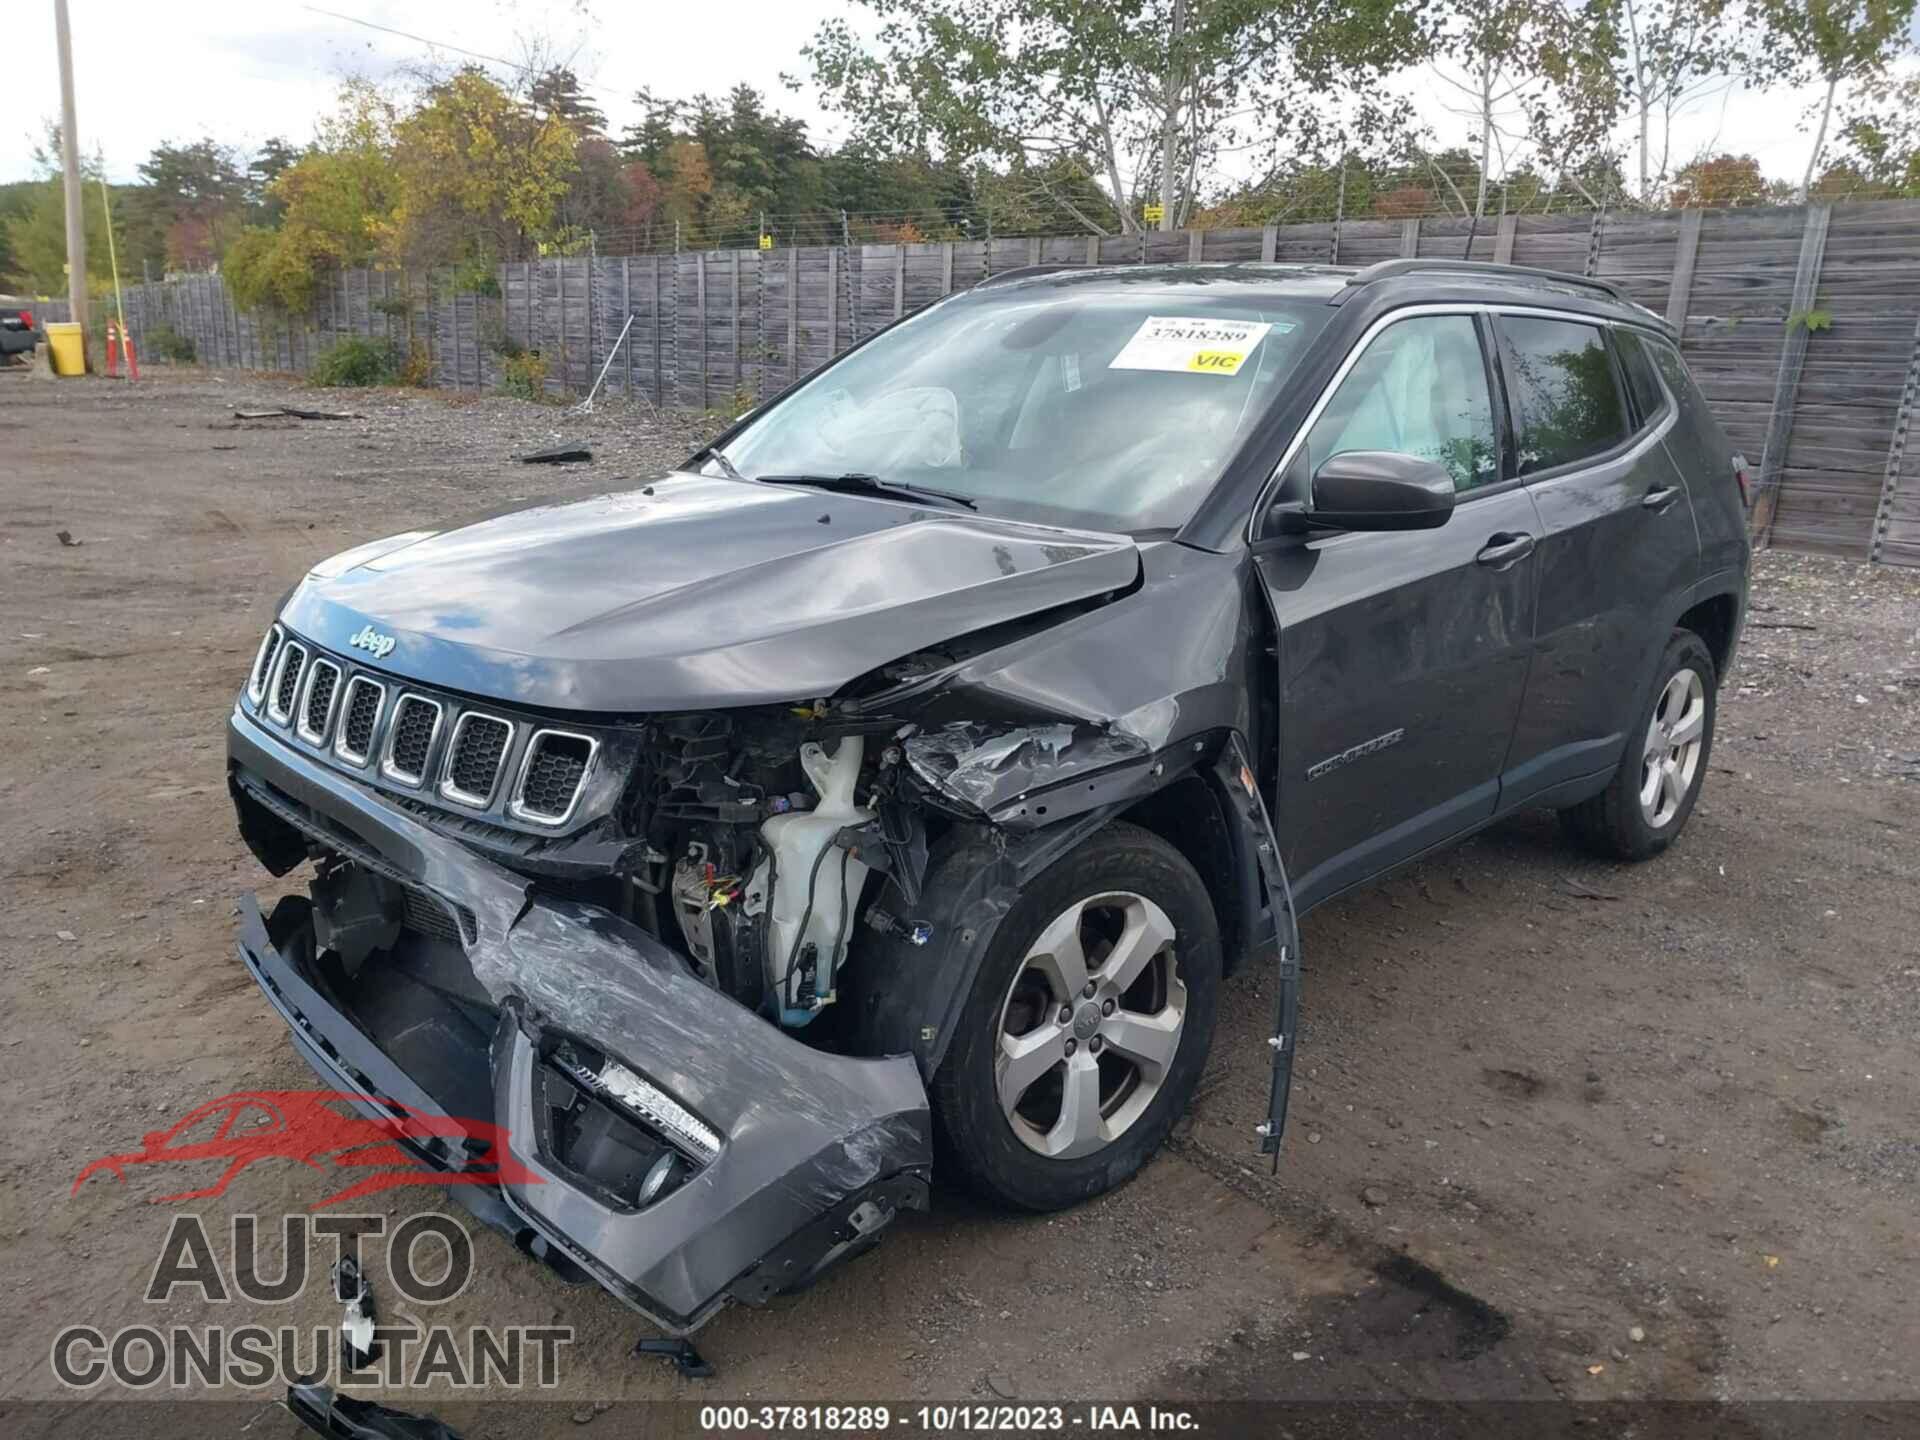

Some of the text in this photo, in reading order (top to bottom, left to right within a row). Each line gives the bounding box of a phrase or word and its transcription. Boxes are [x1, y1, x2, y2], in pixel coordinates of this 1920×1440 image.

[1147, 328, 1248, 341] 37818289
[1196, 354, 1238, 368] VIC
[350, 624, 396, 659] Jeep
